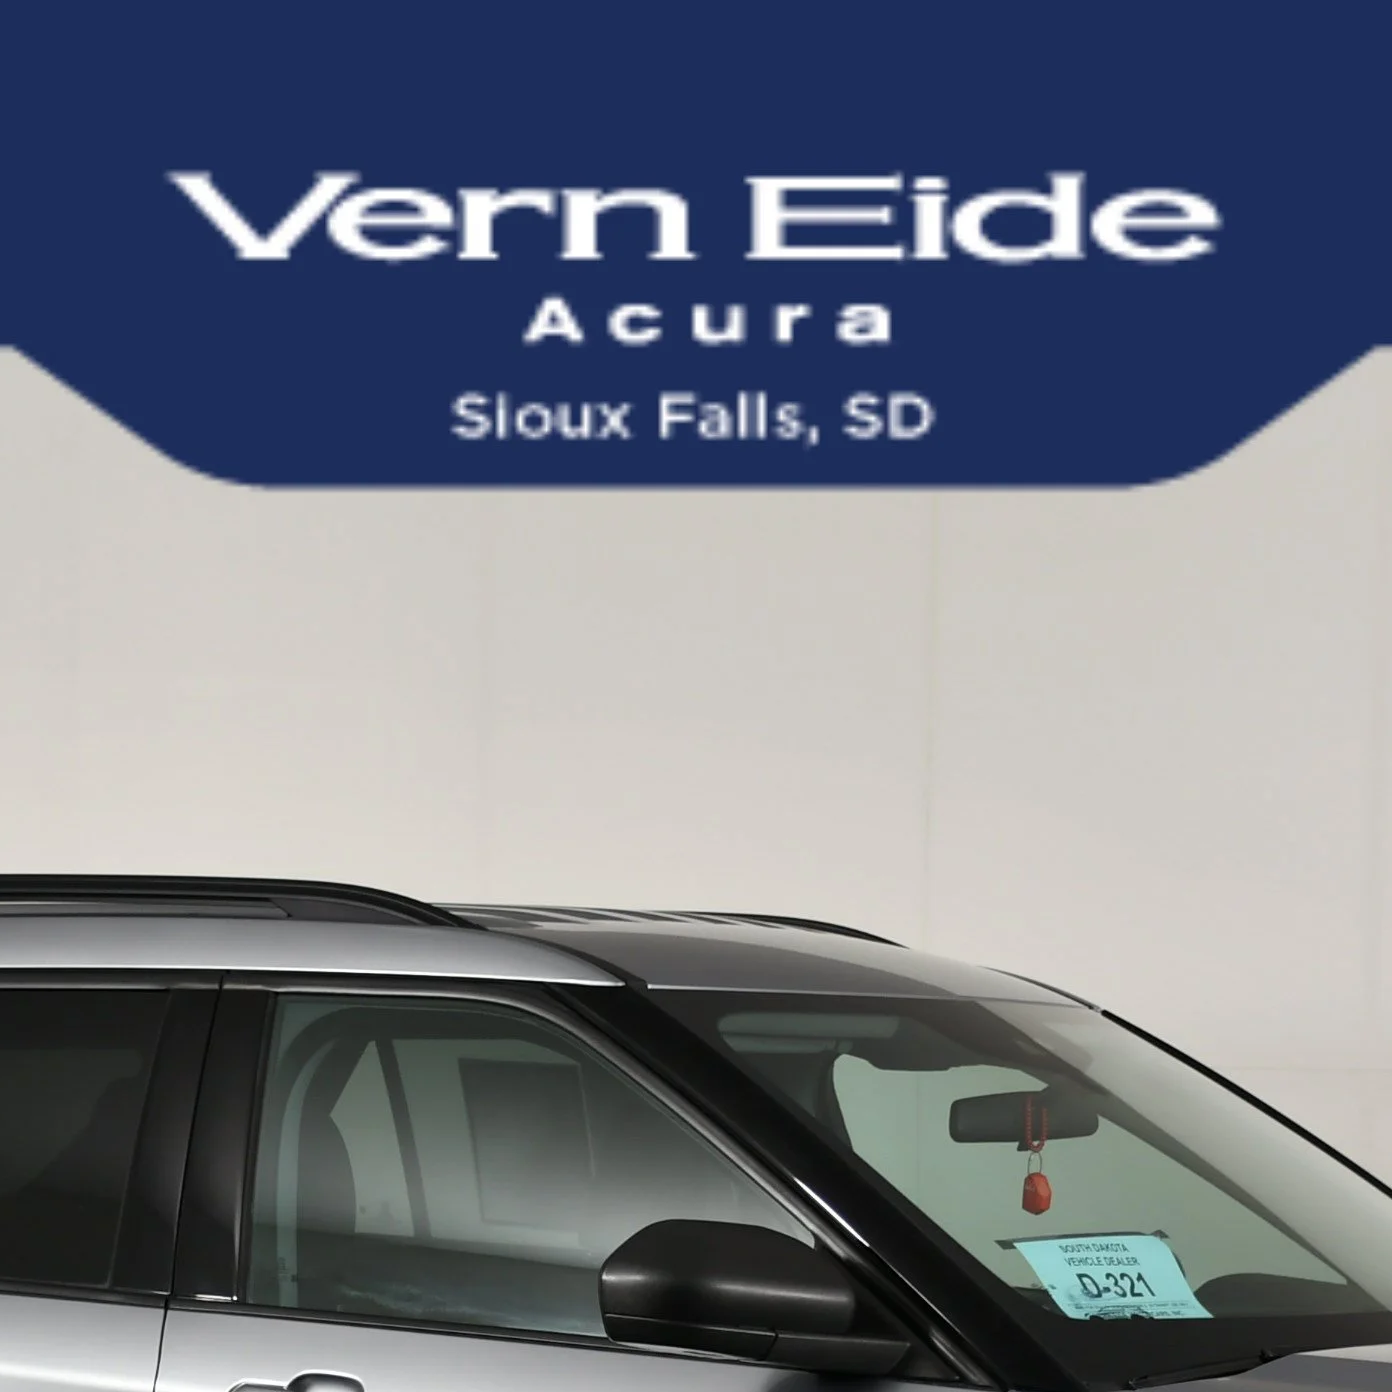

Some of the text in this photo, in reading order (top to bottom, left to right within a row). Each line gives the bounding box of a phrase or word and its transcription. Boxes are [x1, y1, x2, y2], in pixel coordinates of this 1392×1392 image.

[1093, 1242, 1130, 1253] DAKOTA
[1064, 1256, 1141, 1267] VEHICLE DEALER
[1075, 1271, 1157, 1299] D-321
